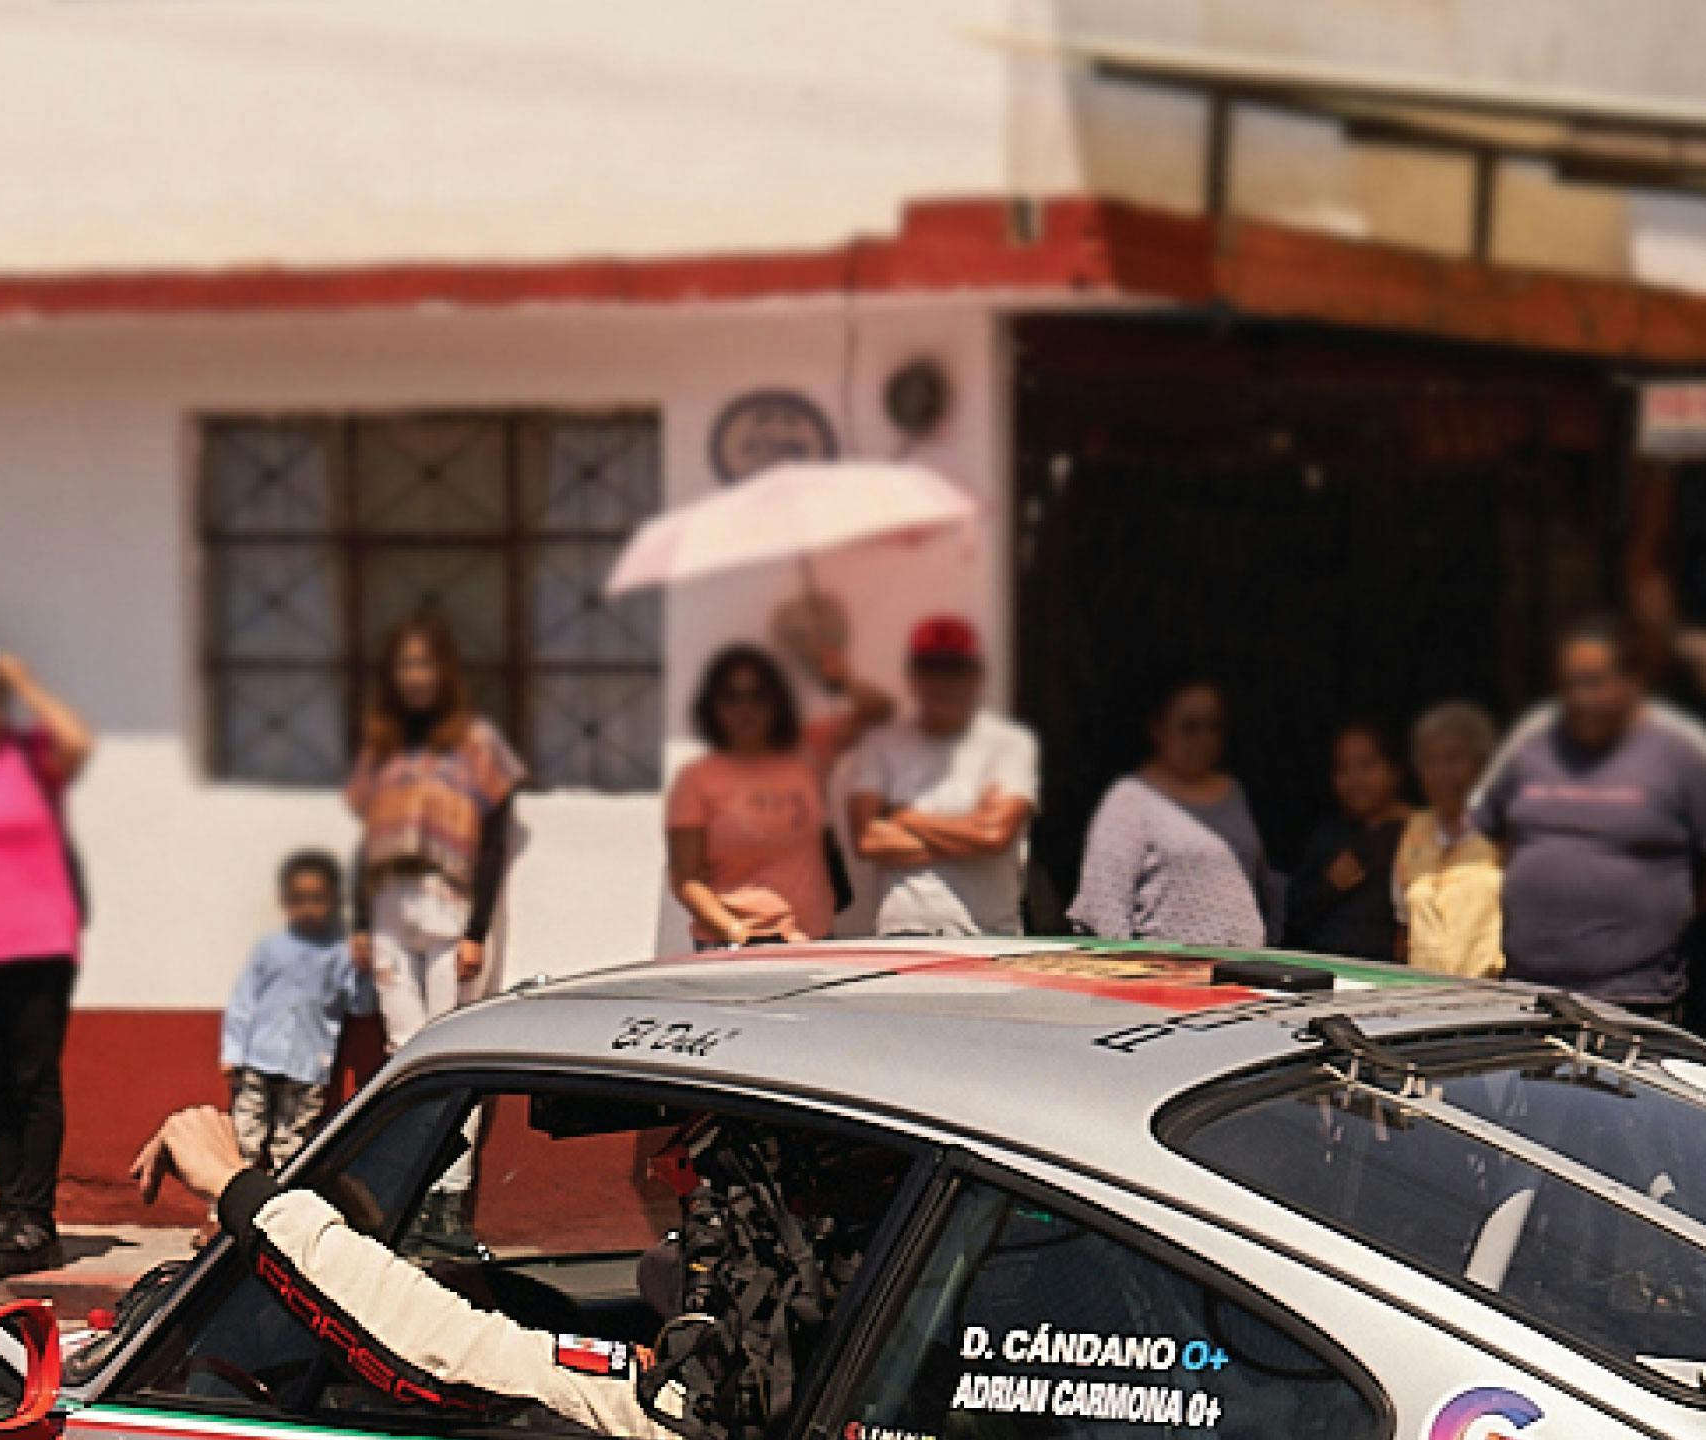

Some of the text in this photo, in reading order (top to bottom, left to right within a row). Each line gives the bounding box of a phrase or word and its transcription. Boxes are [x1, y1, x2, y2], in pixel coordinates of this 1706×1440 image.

[959, 1325, 995, 1360] D.
[1002, 1322, 1176, 1370] CÁNDANO
[950, 1372, 1052, 1414] ADRIAN
[1051, 1379, 1185, 1427] CARMONA
